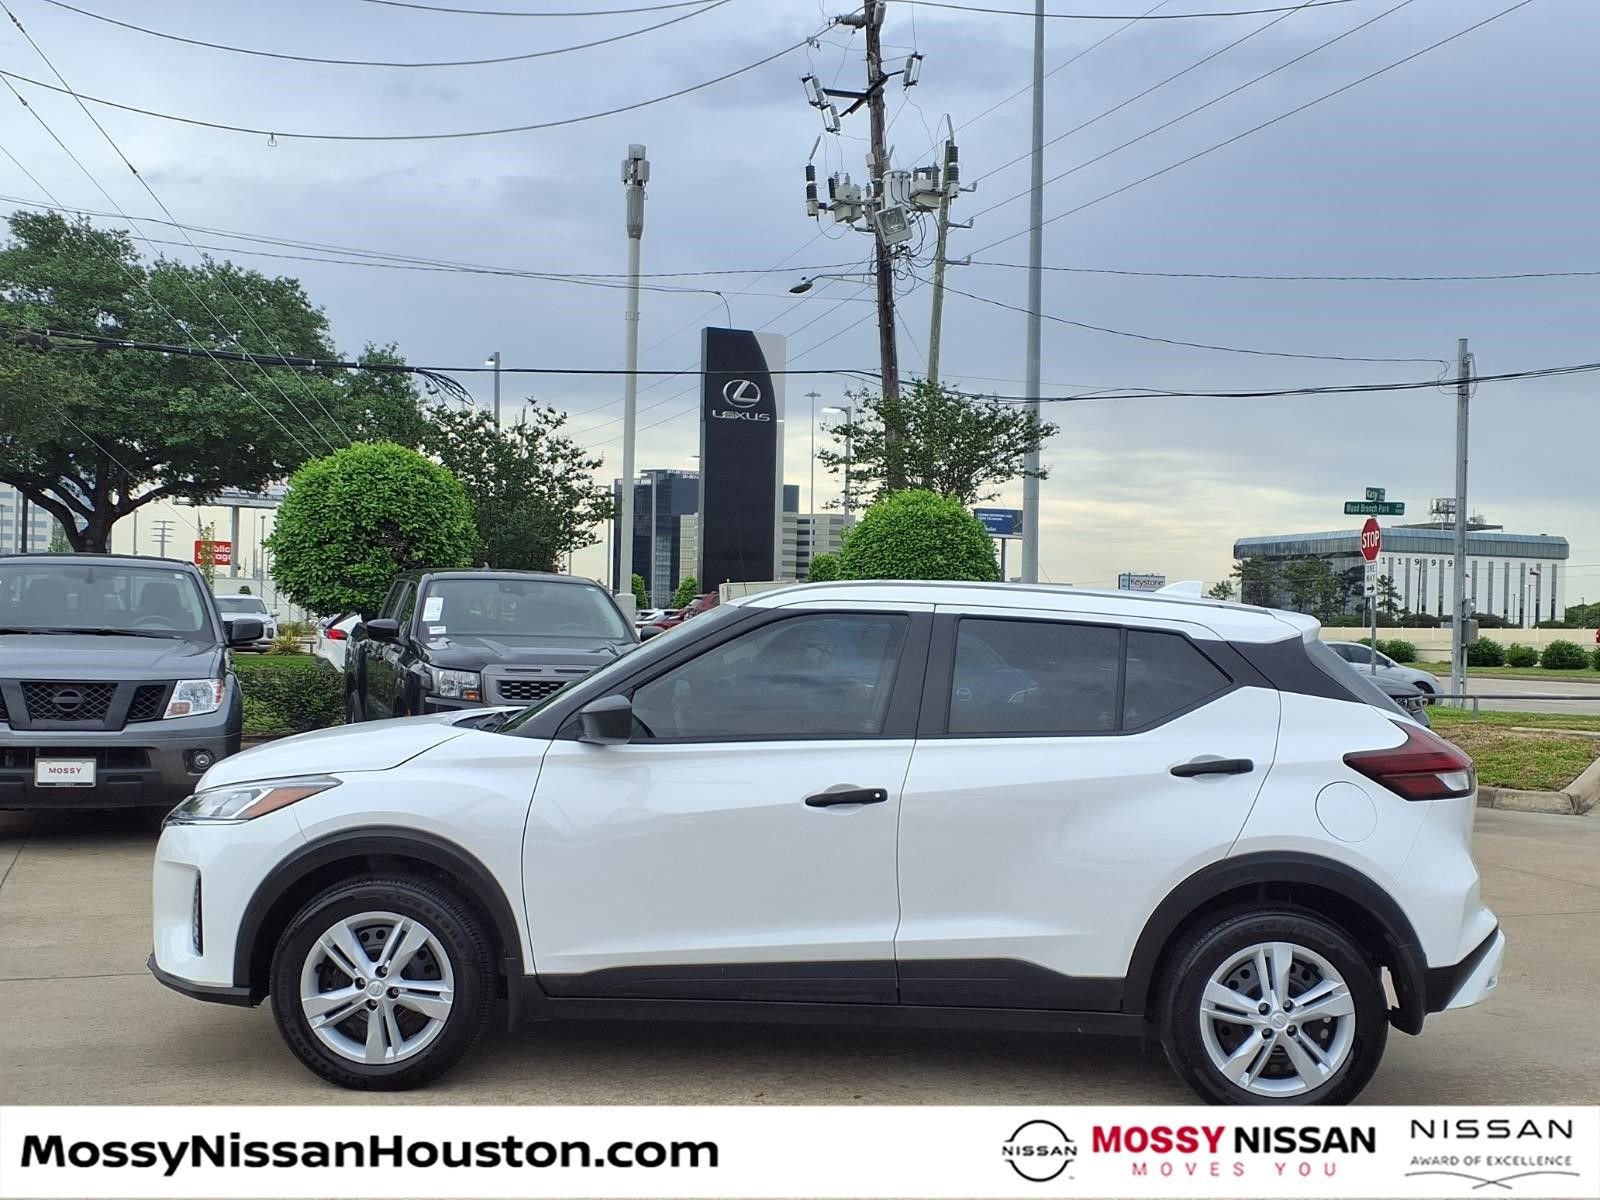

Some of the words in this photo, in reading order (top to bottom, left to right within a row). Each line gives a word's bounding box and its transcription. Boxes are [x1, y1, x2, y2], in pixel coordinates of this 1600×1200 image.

[712, 409, 771, 422] LEXUS
[1346, 503, 1360, 513] Wood
[1360, 503, 1378, 513] Branch
[1378, 503, 1390, 513] Park
[1362, 530, 1380, 549] STOP
[197, 552, 231, 562] Sage
[1366, 563, 1376, 573] ONE
[1366, 574, 1376, 582] WAY
[1130, 579, 1165, 588] Keystone
